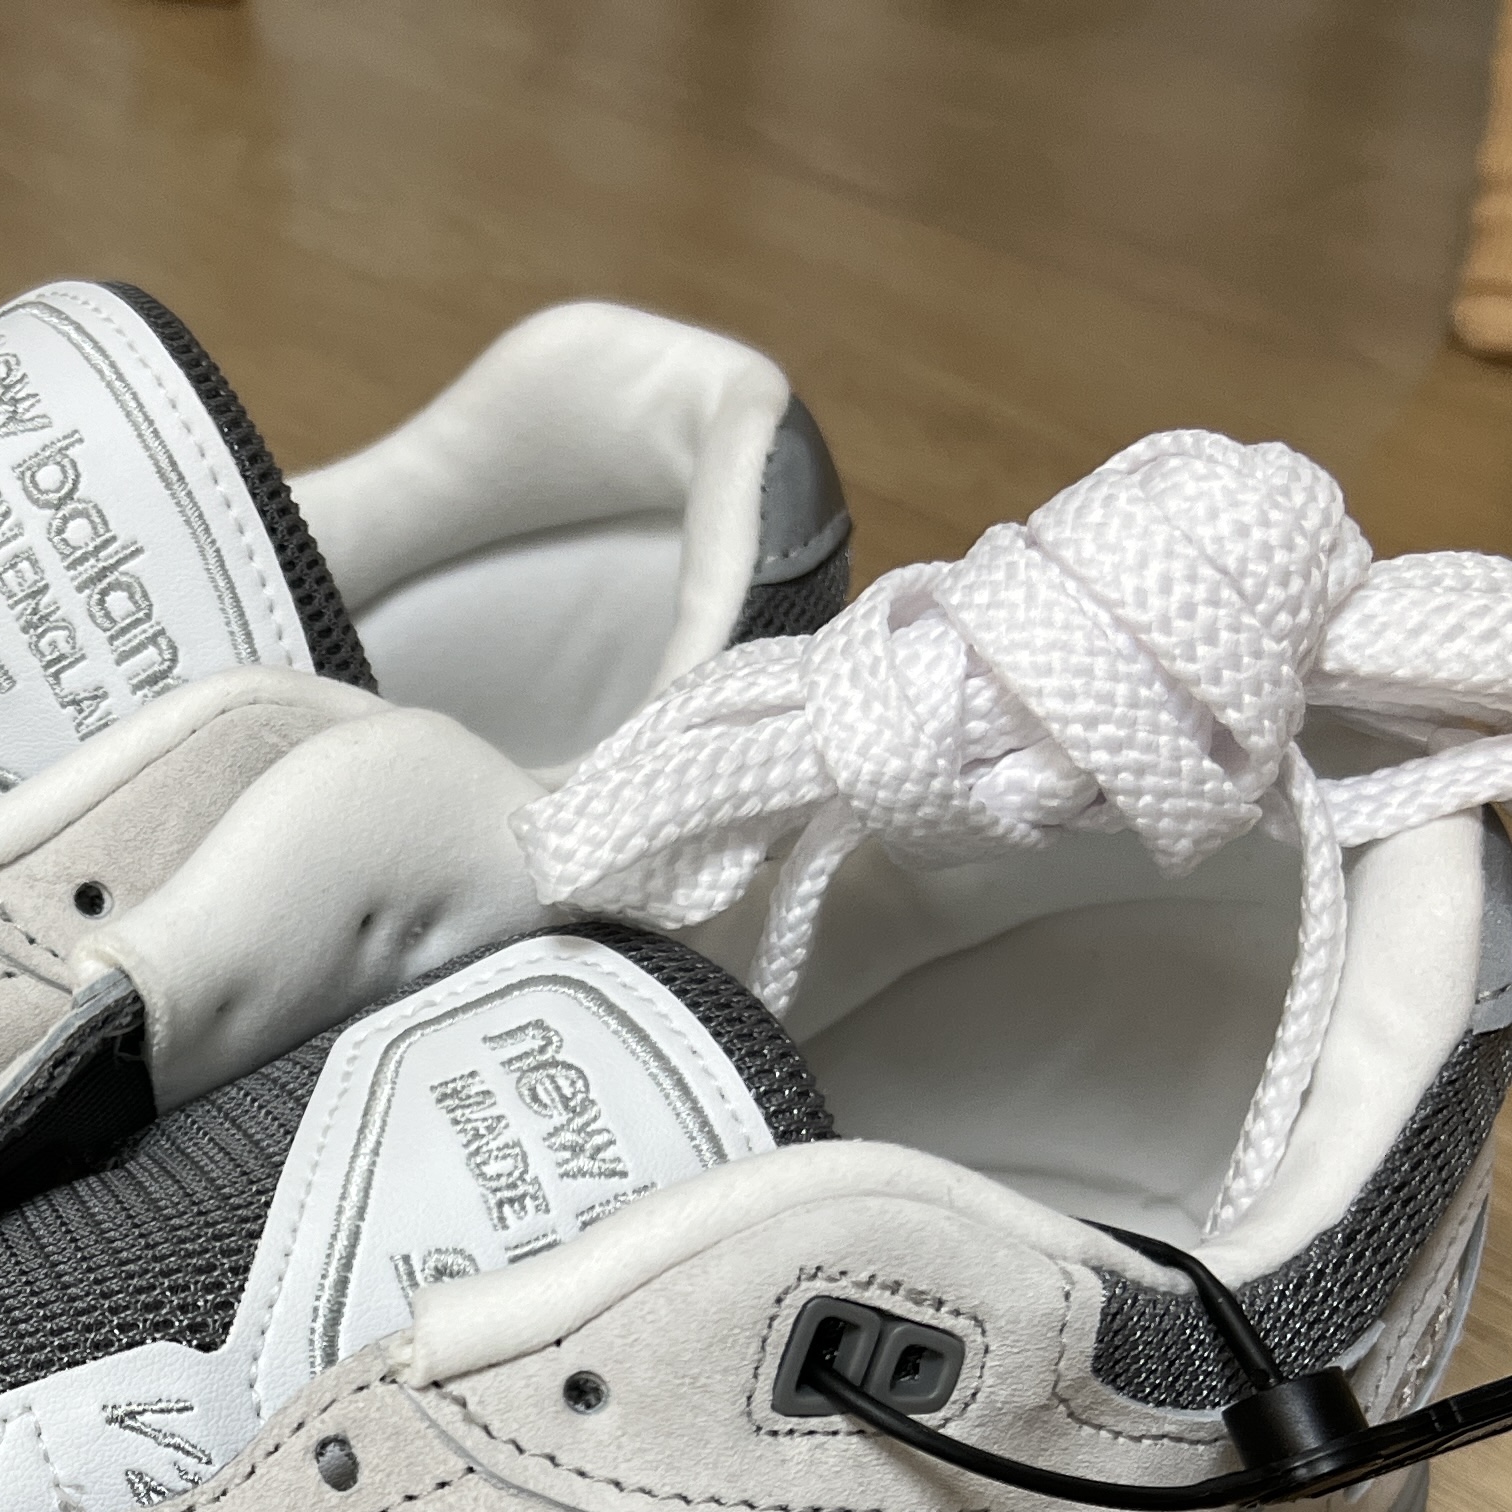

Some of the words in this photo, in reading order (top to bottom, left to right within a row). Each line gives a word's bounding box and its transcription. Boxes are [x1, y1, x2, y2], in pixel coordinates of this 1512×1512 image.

[11, 429, 188, 704] balan
[429, 1069, 551, 1232] MADE
[481, 1018, 629, 1180] new
